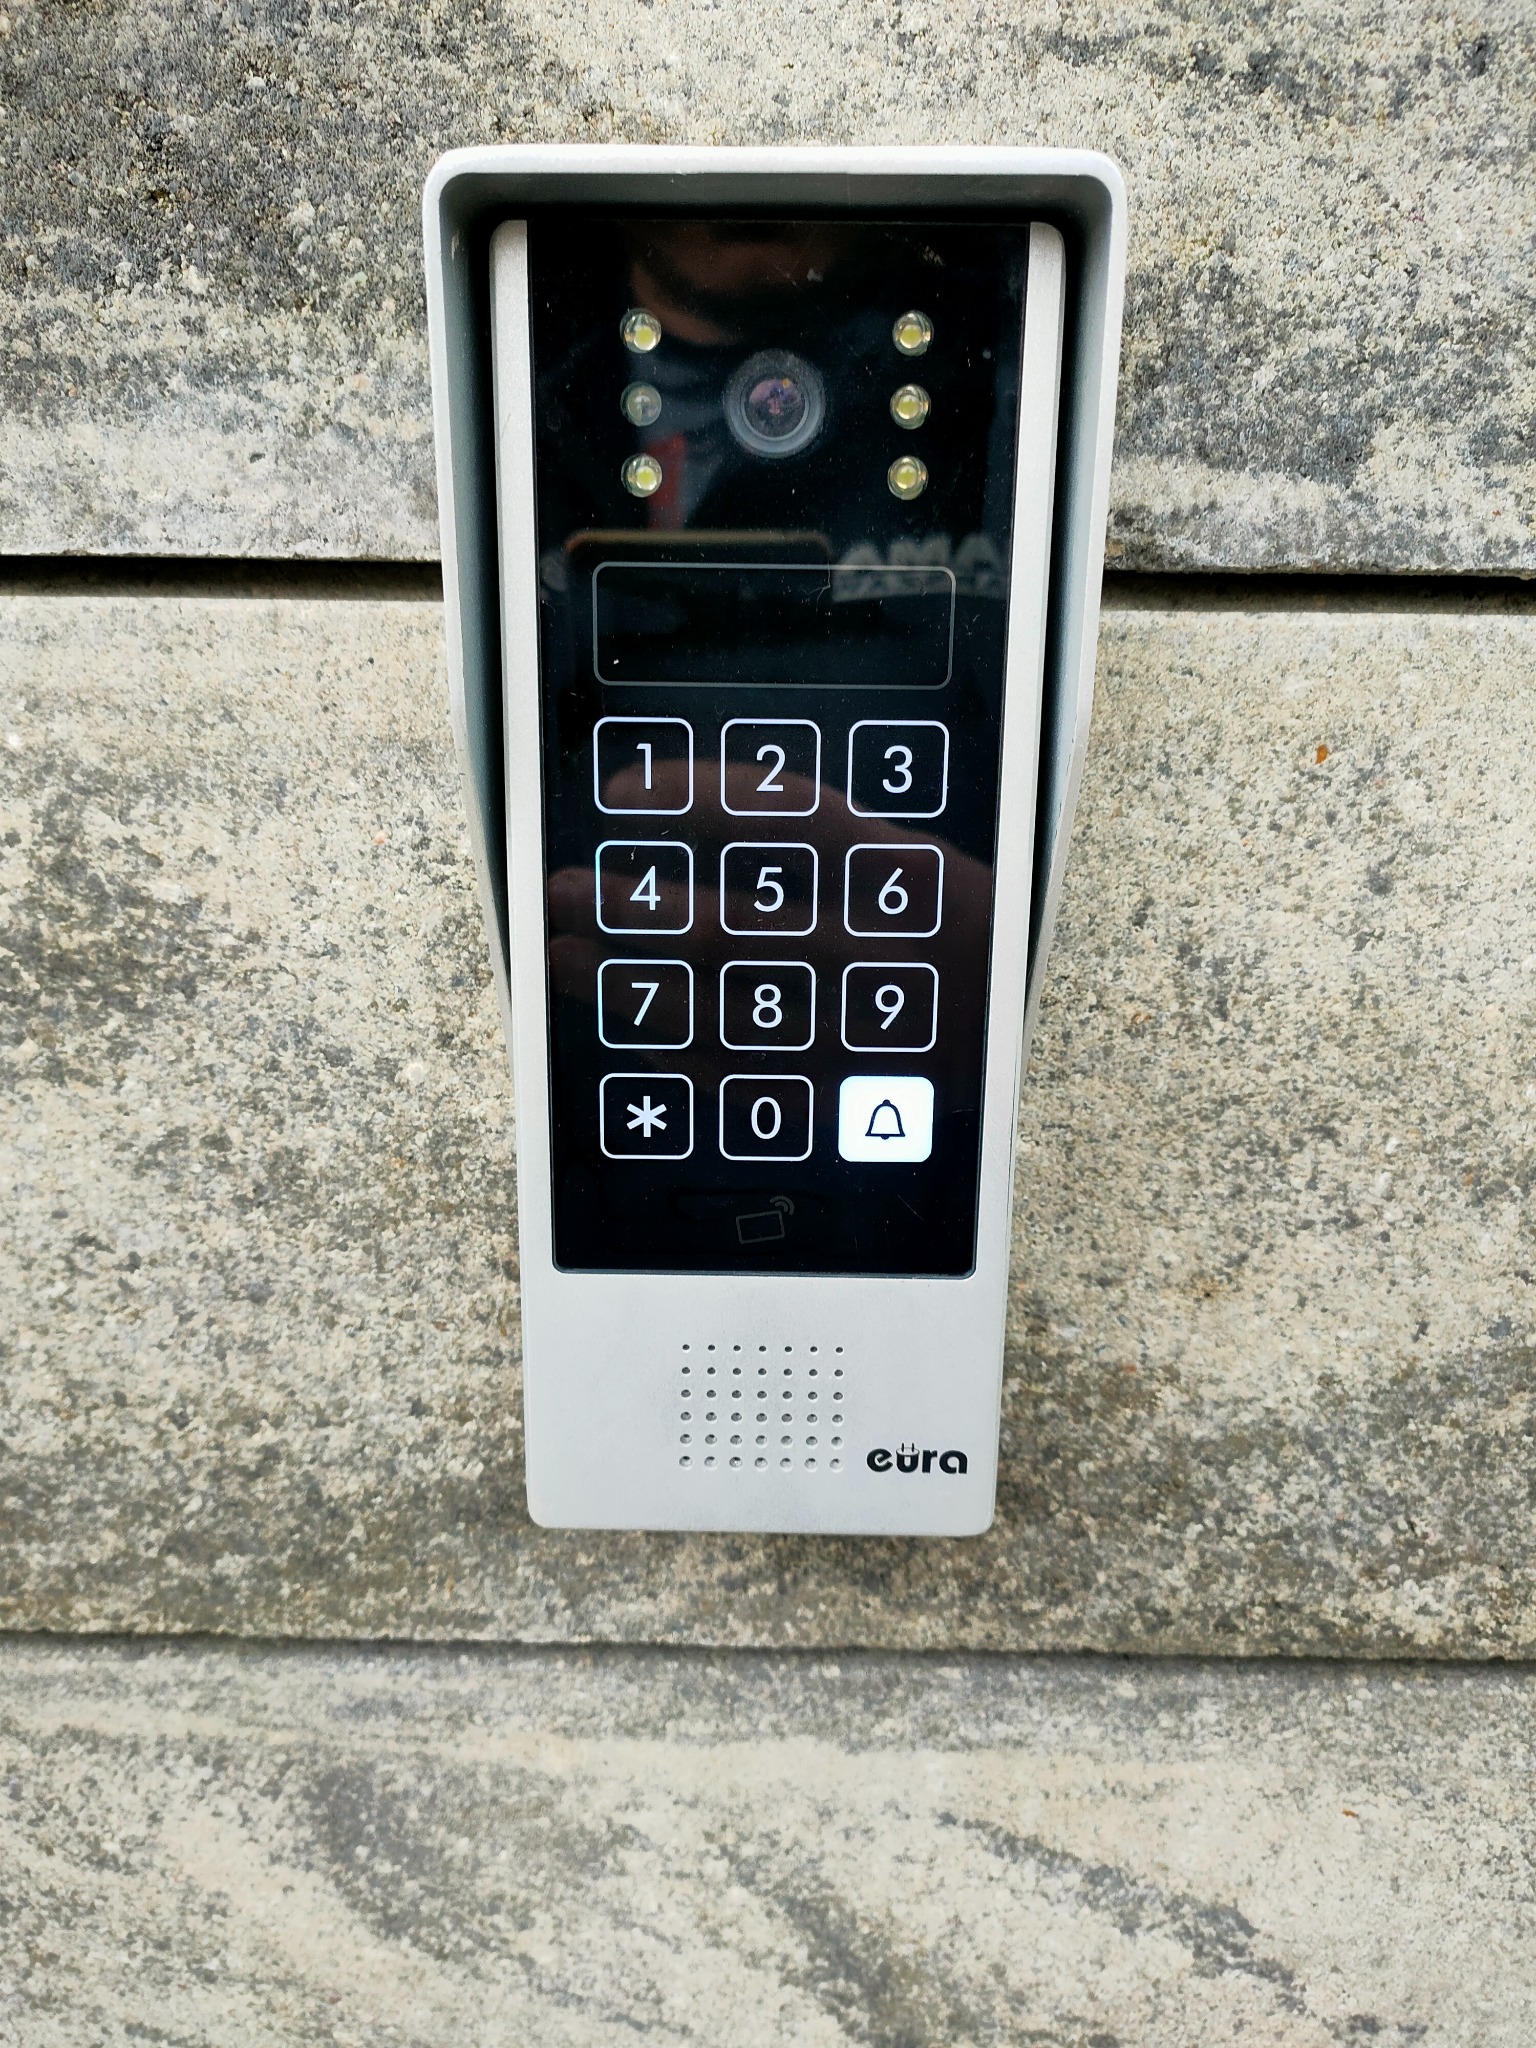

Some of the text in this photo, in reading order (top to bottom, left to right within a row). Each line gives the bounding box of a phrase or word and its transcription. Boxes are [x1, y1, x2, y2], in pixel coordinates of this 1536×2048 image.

[637, 744, 913, 793] 1 2 3
[630, 866, 909, 914] 4 5 6
[632, 983, 905, 1029] 7 8 9
[751, 1097, 782, 1140] 0
